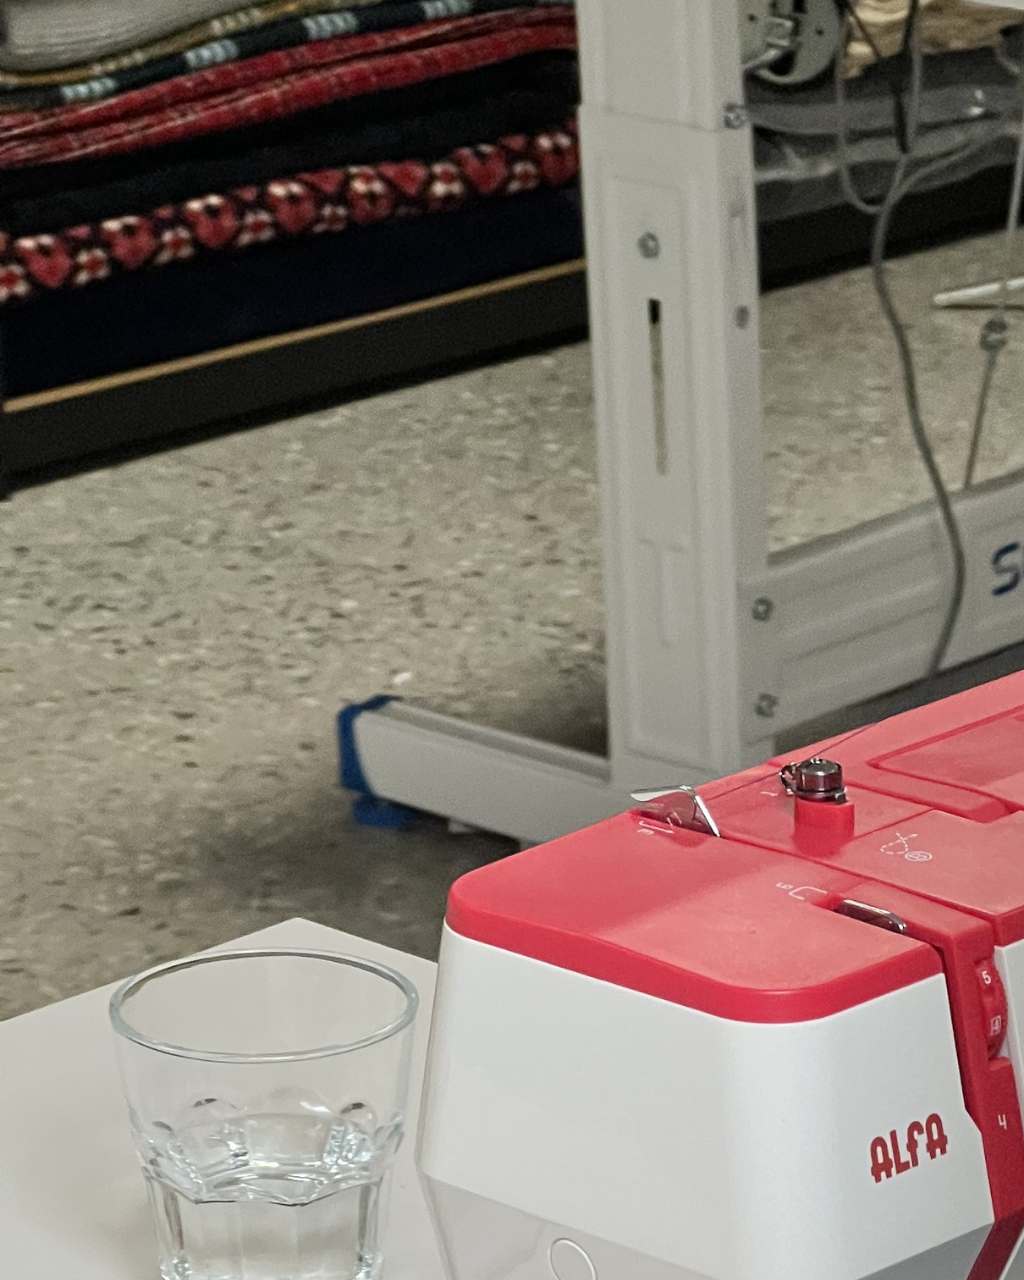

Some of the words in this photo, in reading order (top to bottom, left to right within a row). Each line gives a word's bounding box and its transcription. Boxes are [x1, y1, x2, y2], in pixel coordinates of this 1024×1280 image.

[981, 969, 992, 985] 5
[997, 1113, 1008, 1130] 4
[870, 1112, 948, 1184] ALFA
